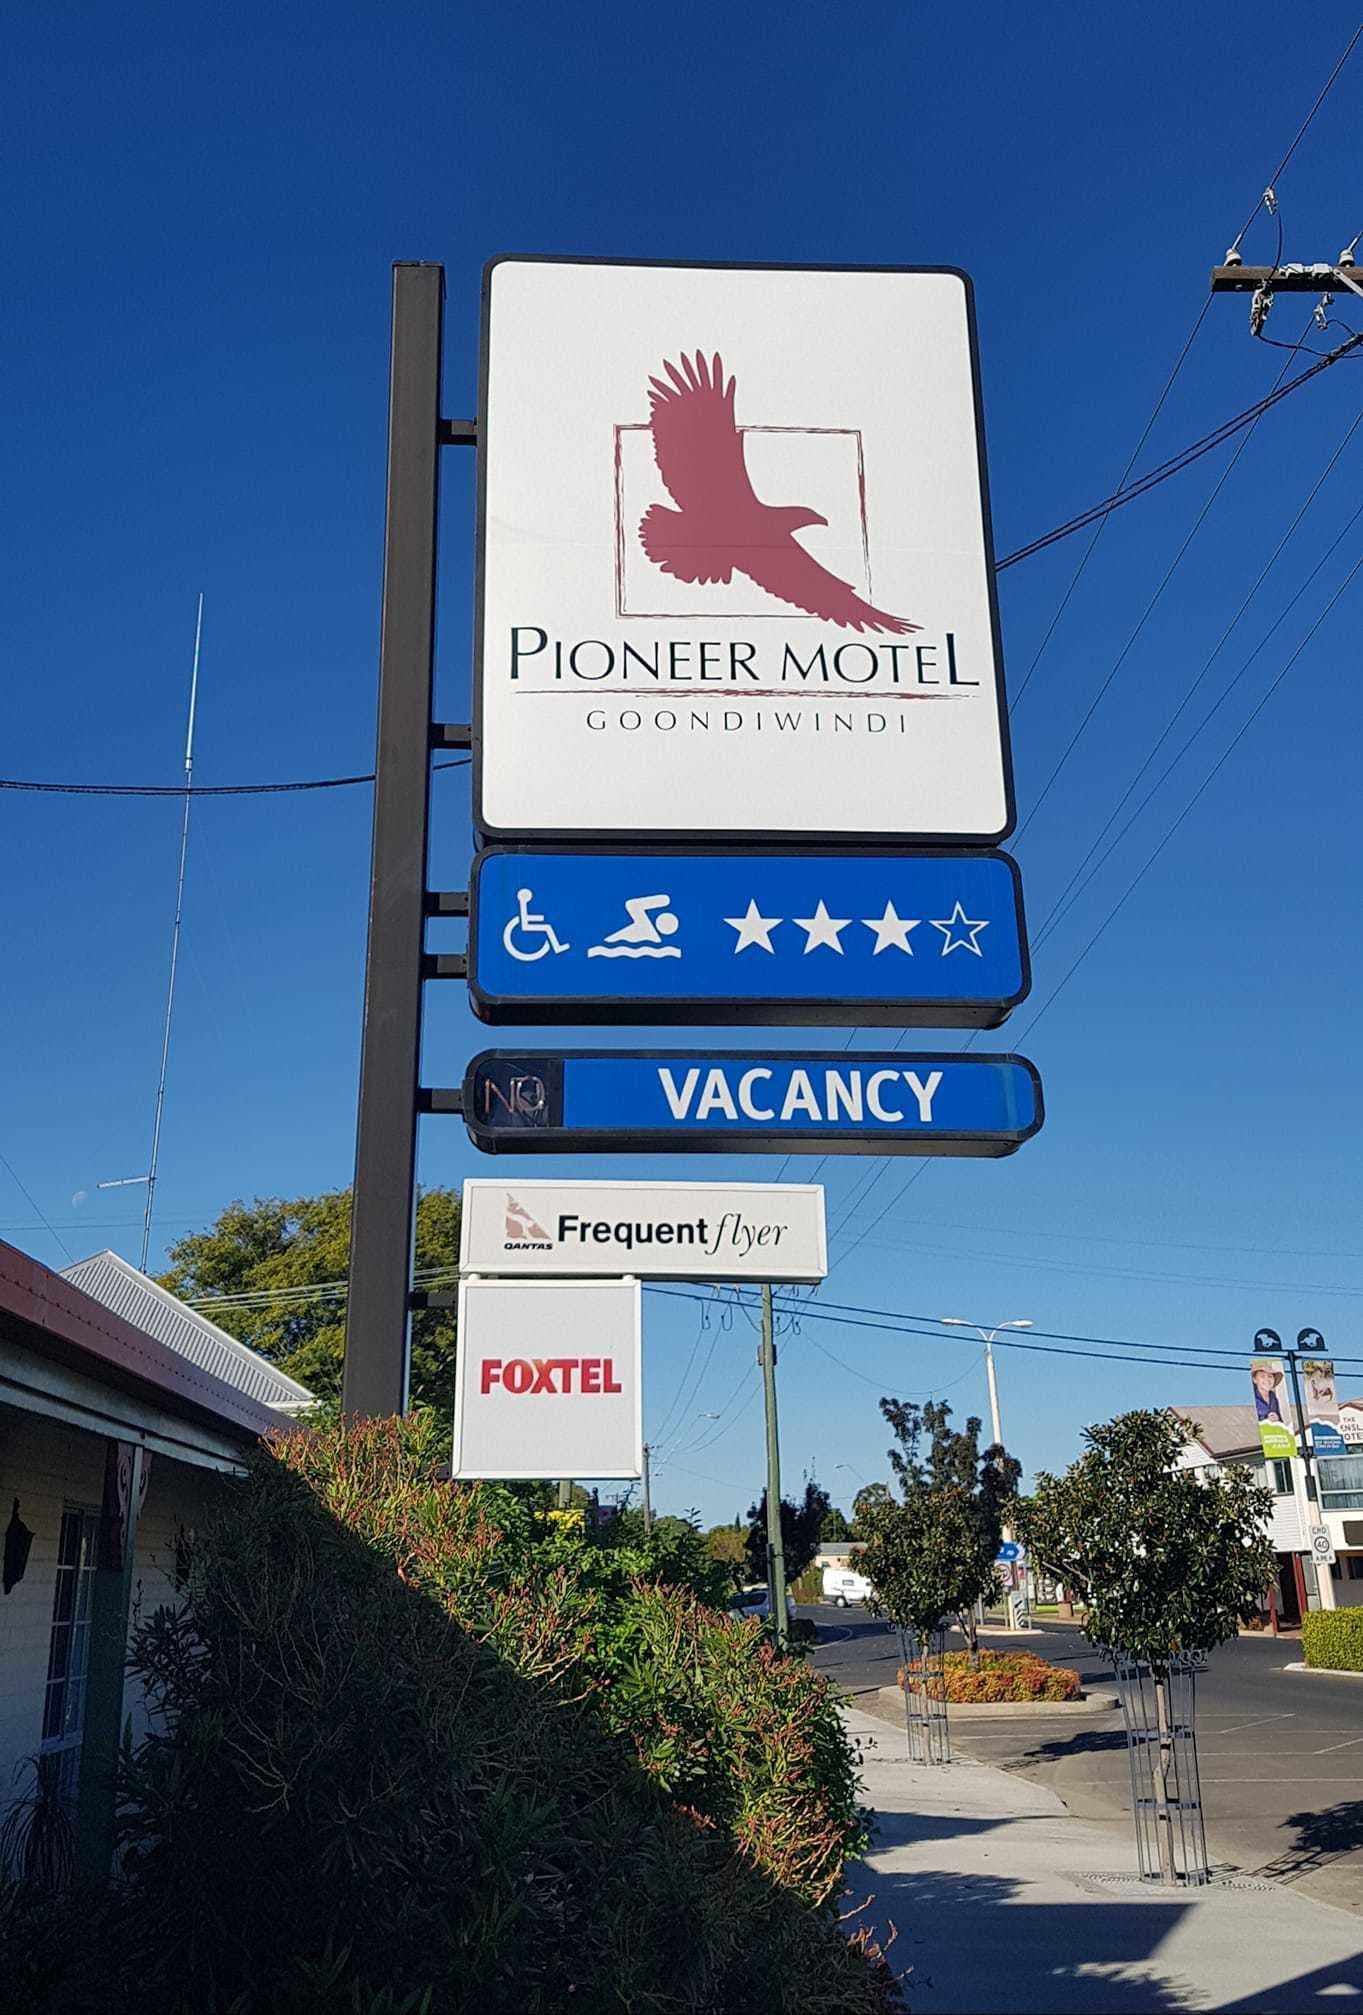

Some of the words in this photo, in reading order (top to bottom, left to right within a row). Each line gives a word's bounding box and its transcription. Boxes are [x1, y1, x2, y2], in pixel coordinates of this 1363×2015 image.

[510, 626, 760, 681] PIONEER
[781, 633, 980, 687] MOTEL
[586, 710, 906, 734] GOONDIWINDI
[658, 1068, 943, 1122] VACANCY
[503, 1242, 552, 1250] QANTAS
[557, 1214, 708, 1250] Frequent
[704, 1212, 788, 1257] flyer
[481, 1359, 622, 1394] FOXTEL
